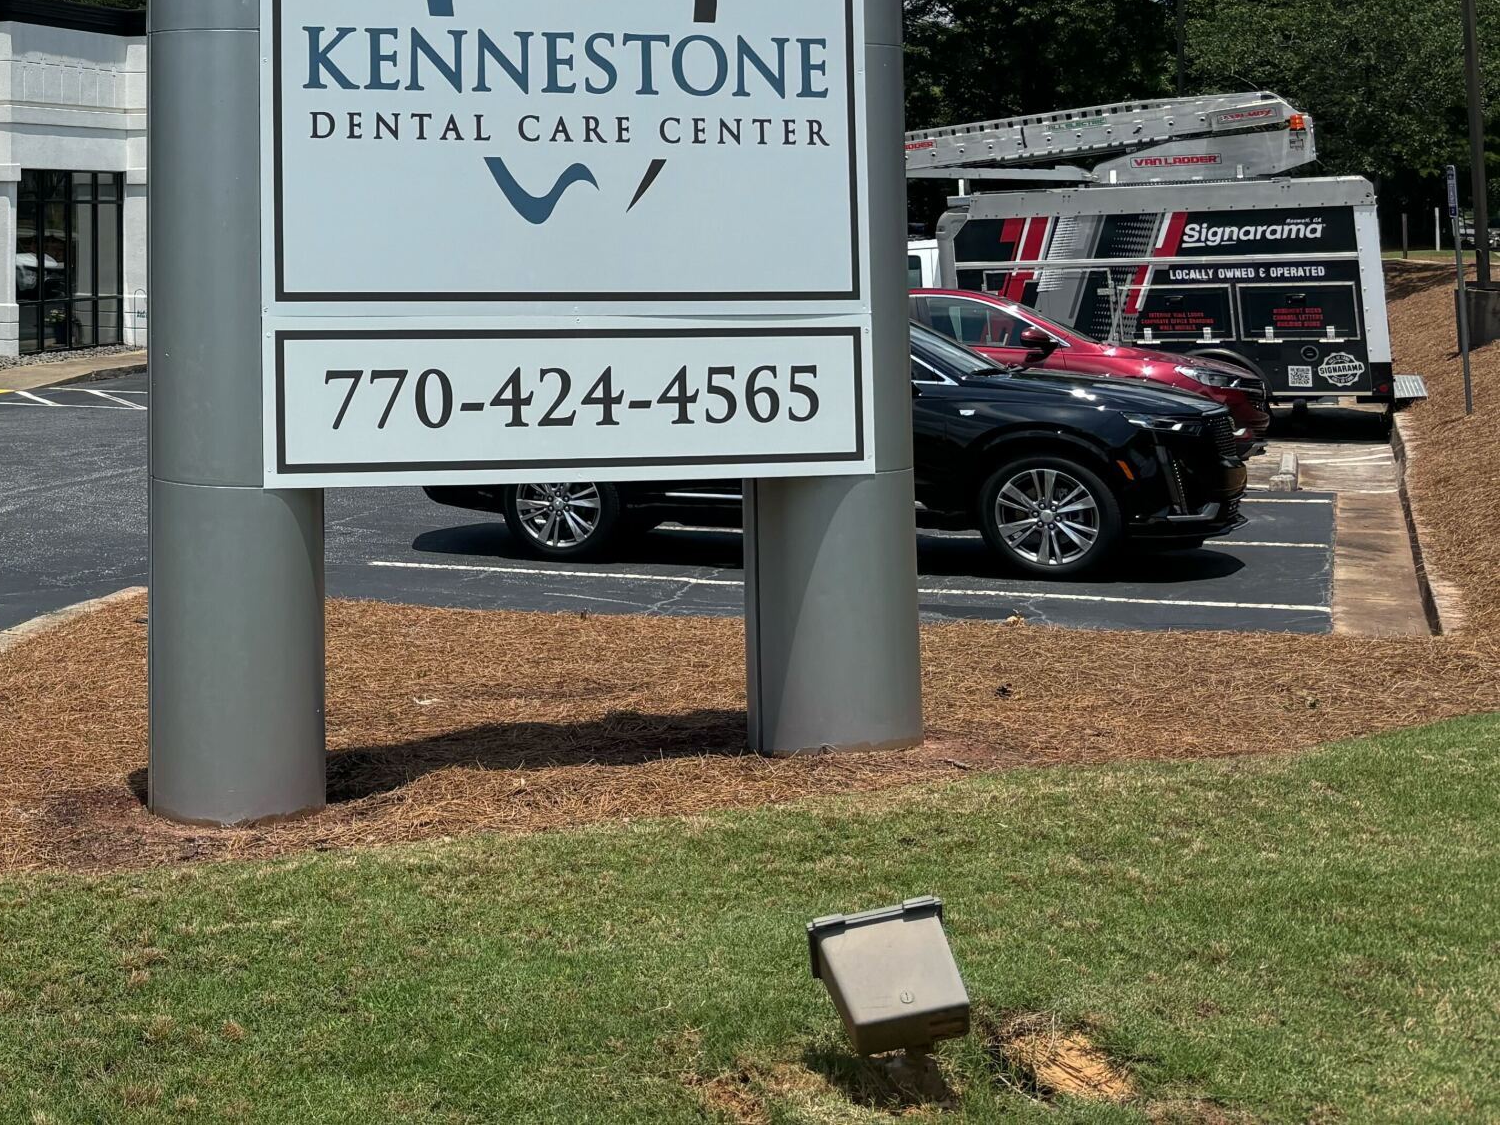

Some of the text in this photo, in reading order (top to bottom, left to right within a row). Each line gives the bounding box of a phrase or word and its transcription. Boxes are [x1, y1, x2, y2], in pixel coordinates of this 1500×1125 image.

[302, 25, 829, 99] KENNESTONE
[309, 111, 830, 147] DENTAL CARE CENTER
[1134, 155, 1219, 166] VAN LADDER
[1182, 223, 1322, 247] Signarama
[1170, 266, 1325, 280] LOCALLY OWNED & OPERATED
[1320, 364, 1363, 374] SIGNARAMA
[323, 364, 821, 430] 770-424-4565
